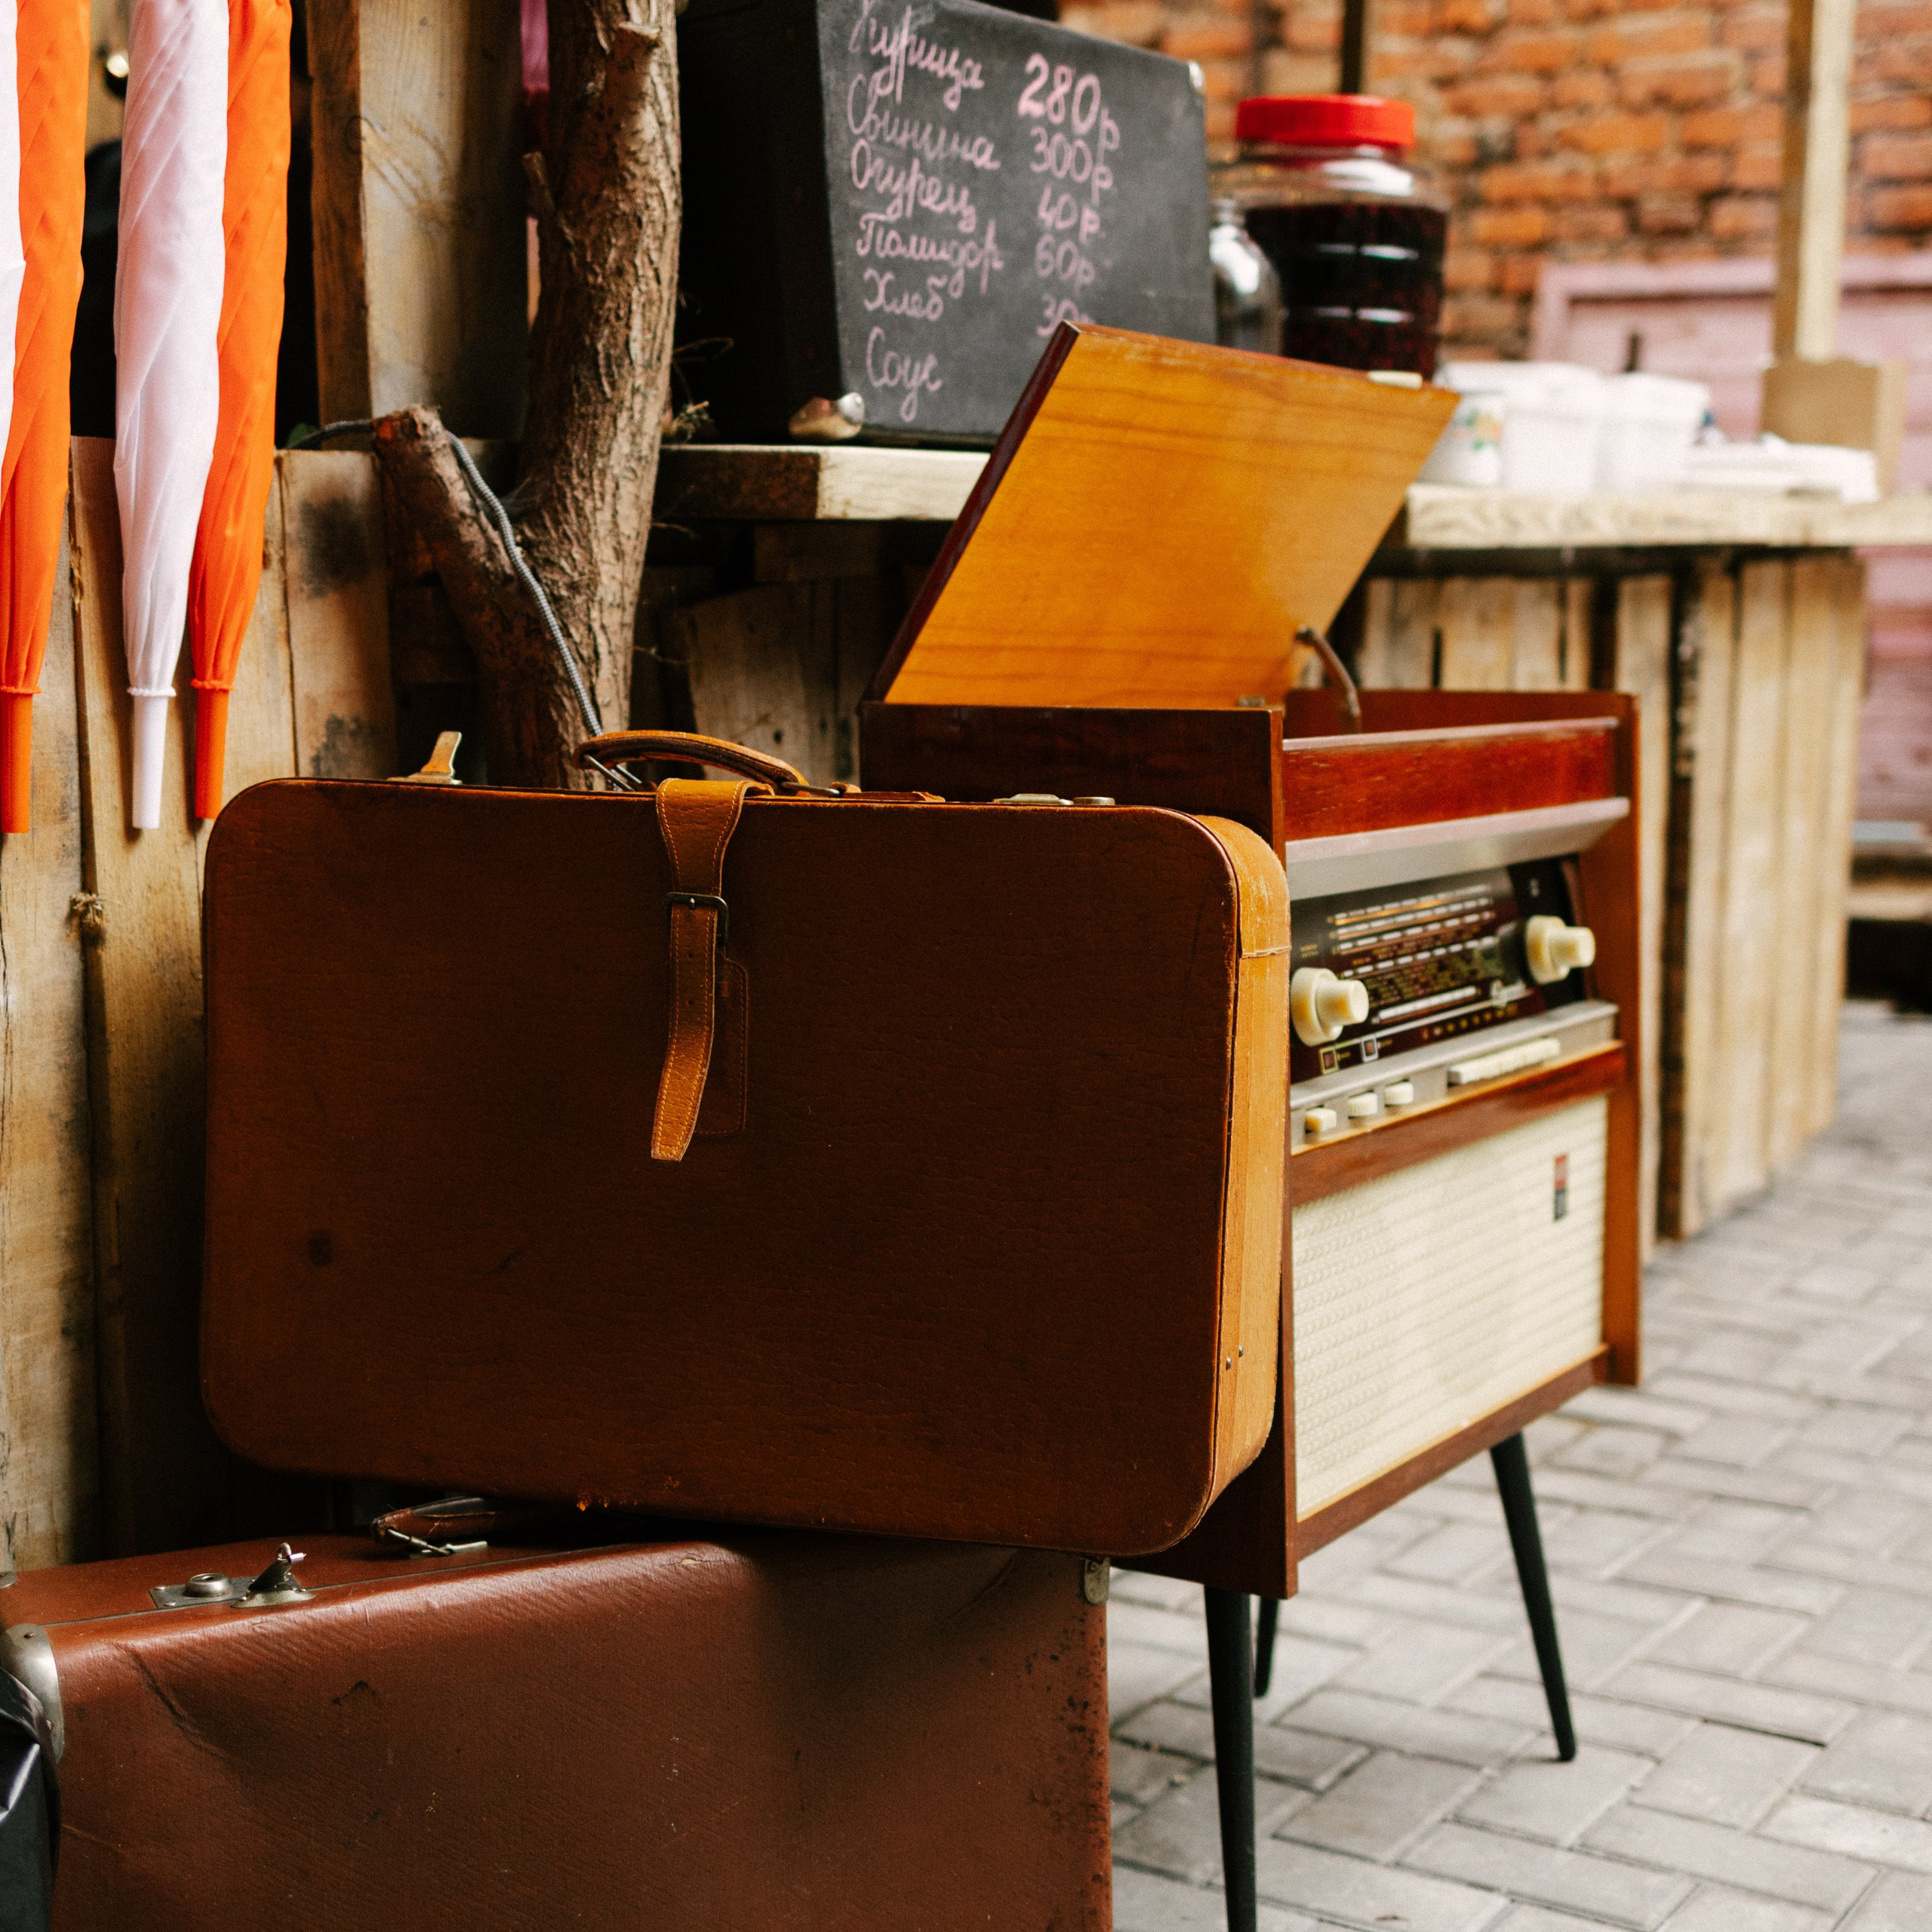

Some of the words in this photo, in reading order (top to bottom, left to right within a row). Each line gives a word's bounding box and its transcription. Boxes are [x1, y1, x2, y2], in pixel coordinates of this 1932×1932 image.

[851, 138, 977, 234] Огурец
[863, 267, 948, 321] Хлеб
[866, 326, 943, 423] Соус
